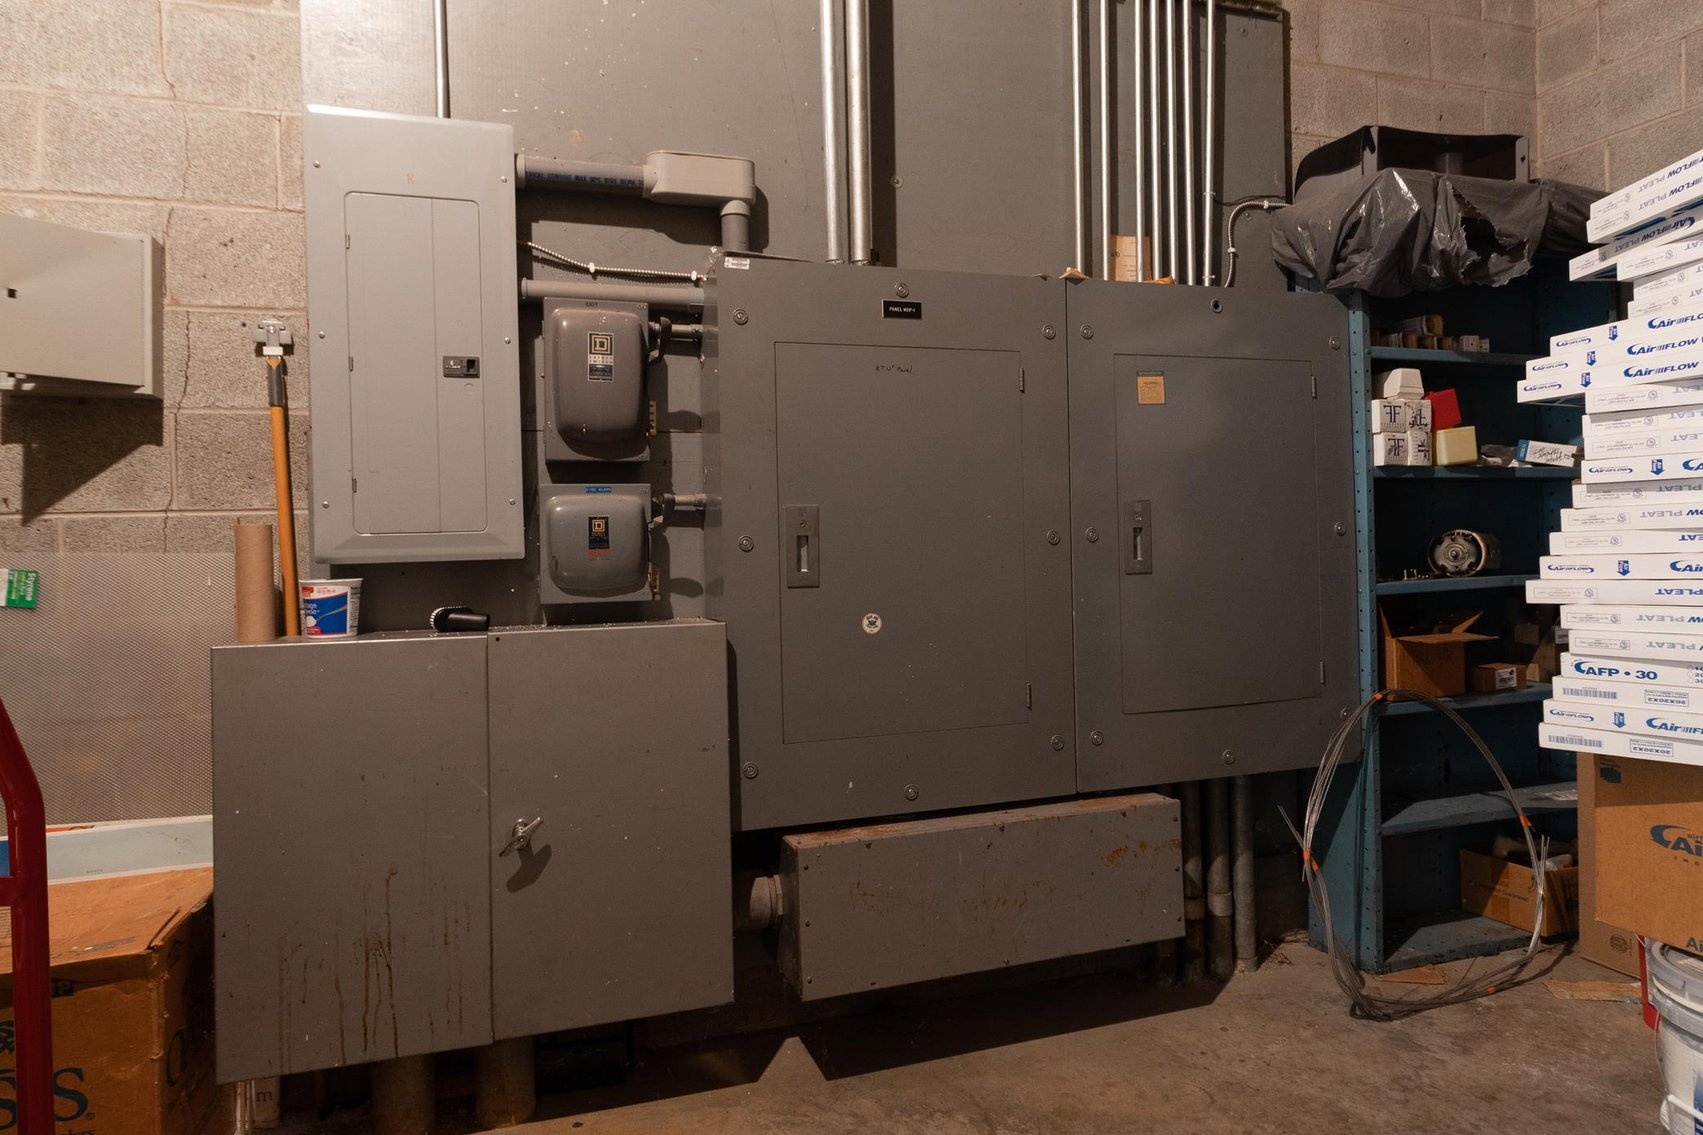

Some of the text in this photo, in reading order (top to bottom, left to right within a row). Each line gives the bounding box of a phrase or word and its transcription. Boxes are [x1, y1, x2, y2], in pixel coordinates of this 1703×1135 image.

[1638, 172, 1665, 193] PLEAT
[1638, 192, 1667, 210] PLEAT
[1615, 235, 1640, 252] PLEAT
[1656, 484, 1702, 492] PLEAT
[1640, 510, 1682, 518] PLEAT
[1636, 615, 1684, 623] PLEAT
[1646, 641, 1696, 651] PLEAT
[1585, 666, 1658, 680] AFP 30
